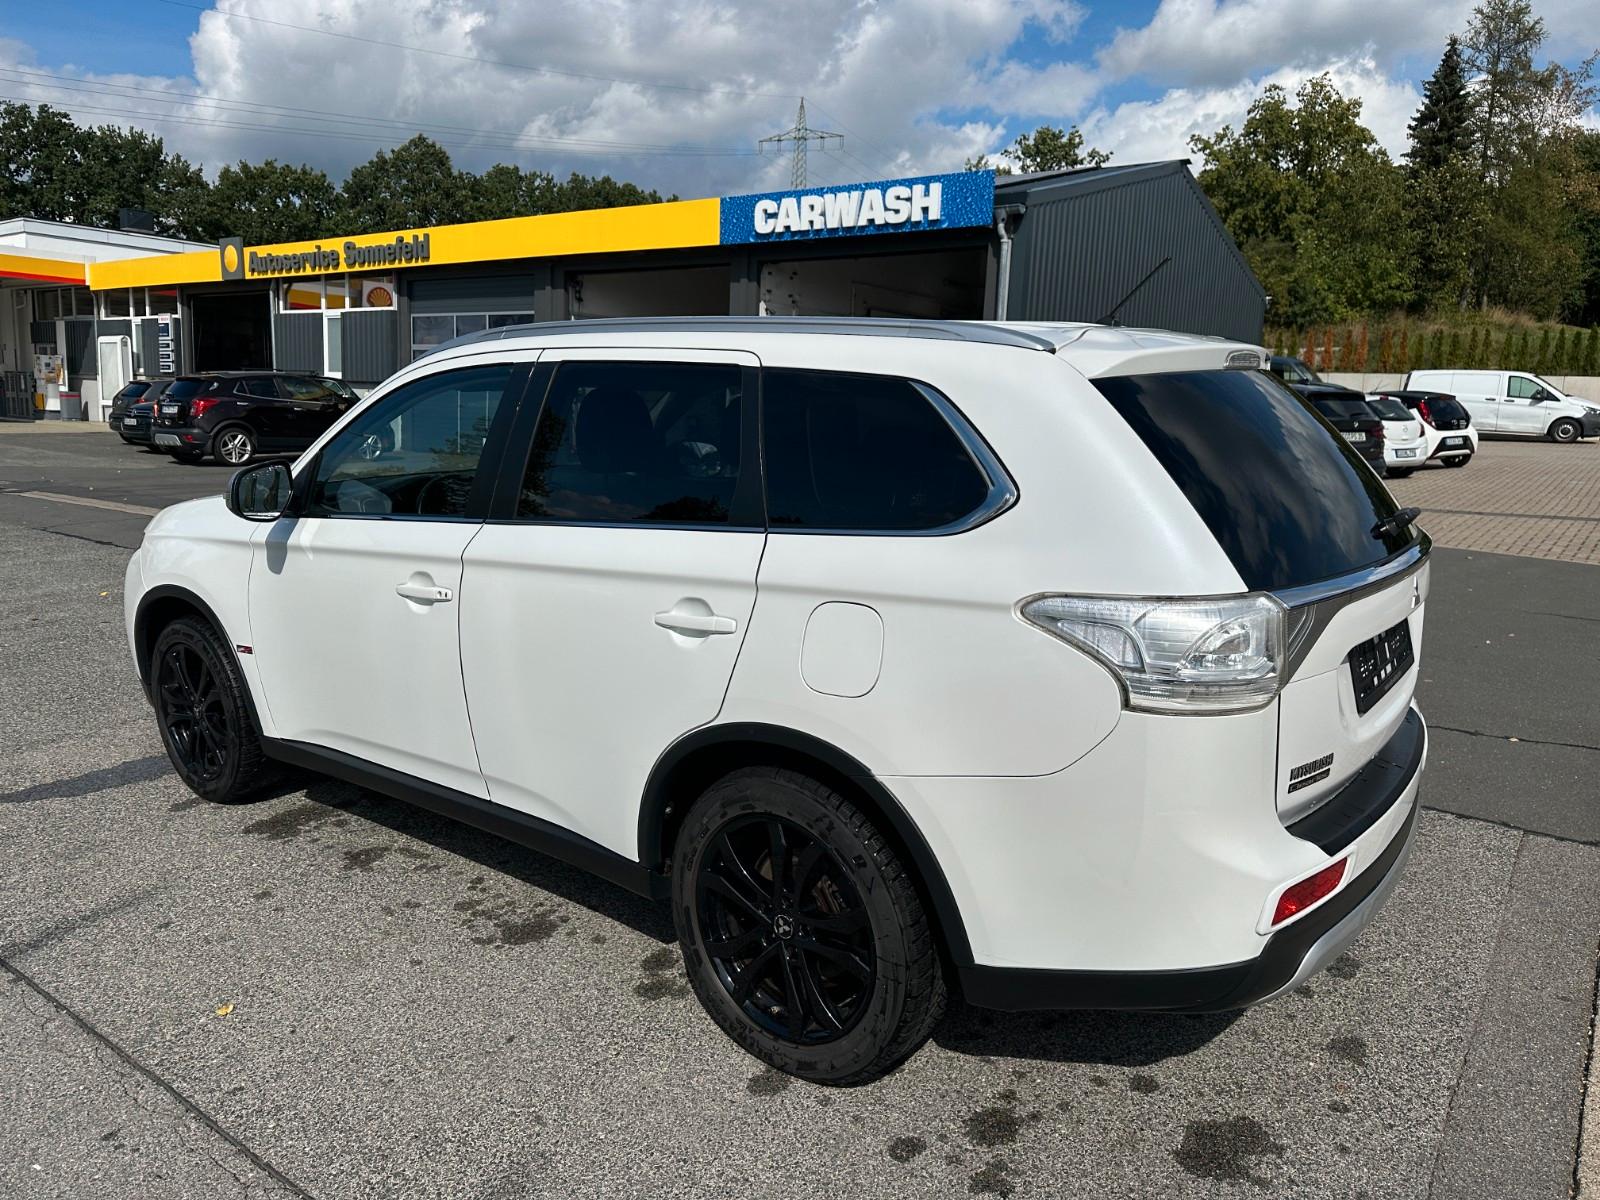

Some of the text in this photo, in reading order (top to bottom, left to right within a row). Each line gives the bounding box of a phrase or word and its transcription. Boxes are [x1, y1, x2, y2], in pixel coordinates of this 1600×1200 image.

[754, 182, 942, 234] CARWASH
[249, 233, 430, 275] Autoservice Sonnefeld
